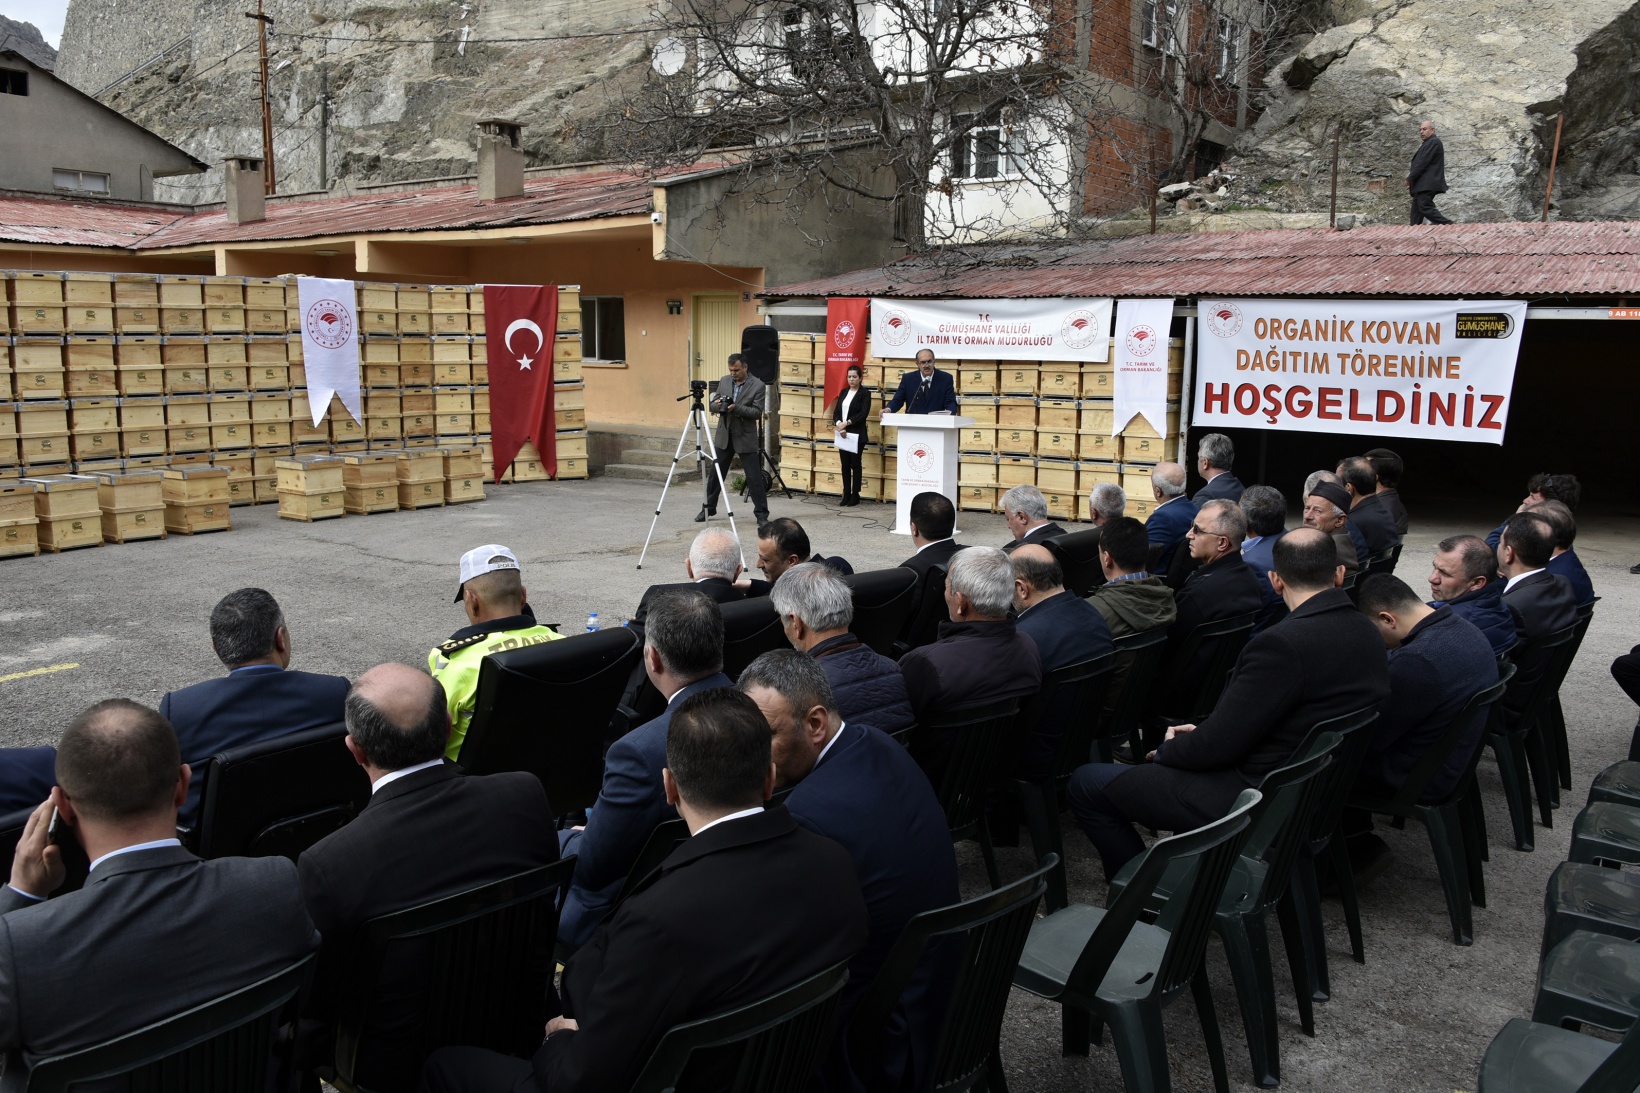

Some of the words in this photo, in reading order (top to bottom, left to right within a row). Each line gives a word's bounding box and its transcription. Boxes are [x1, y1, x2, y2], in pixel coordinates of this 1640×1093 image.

[979, 314, 992, 322] T.C.
[939, 322, 992, 335] GÜMÜŞHANE
[995, 323, 1031, 334] VALİLİĞİ
[1254, 314, 1355, 343] ORGANİK
[1362, 321, 1441, 345] KOVAN
[1457, 321, 1506, 331] GÜMÜŞHANE
[917, 332, 924, 344] İL
[926, 335, 950, 345] TARIM
[952, 336, 961, 345] VE
[964, 336, 995, 346] ORMAN
[997, 335, 1053, 346] MÜDÜRLÜĞÜ
[1236, 345, 1330, 375] DAĞITIM
[1337, 348, 1461, 379] TÖRENİNE
[1203, 382, 1506, 430] HOŞGELDİNİZ
